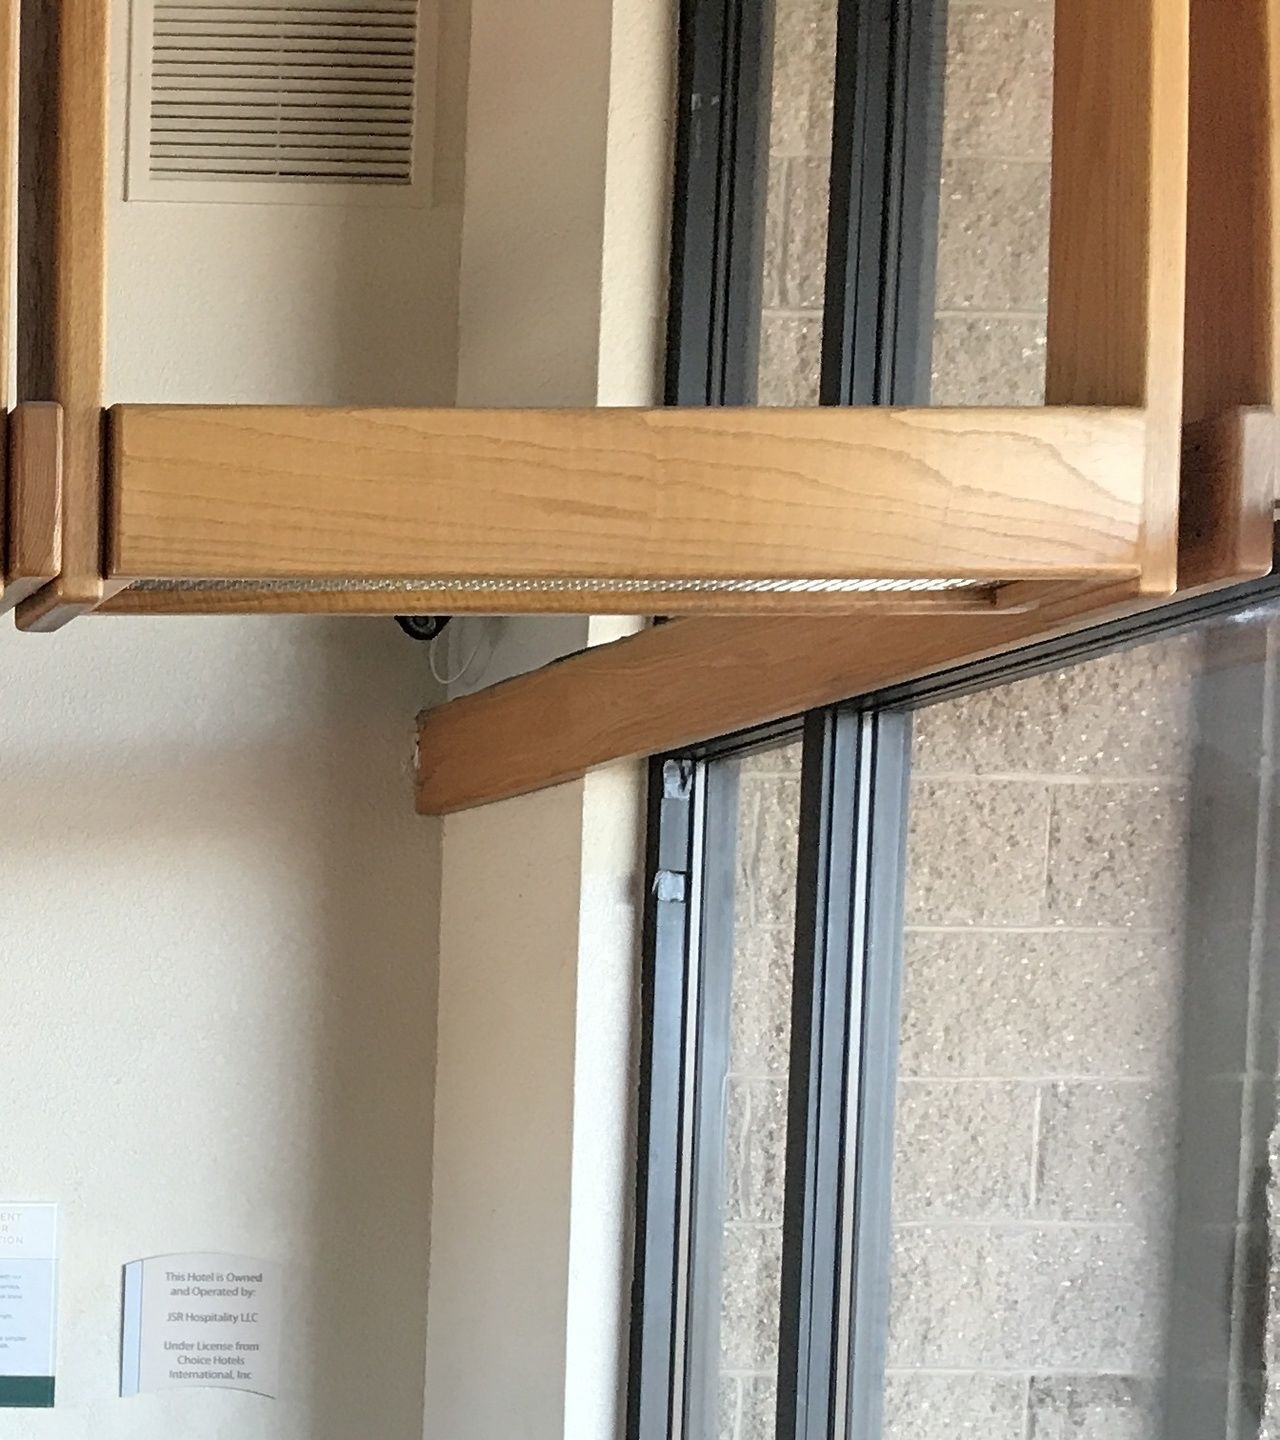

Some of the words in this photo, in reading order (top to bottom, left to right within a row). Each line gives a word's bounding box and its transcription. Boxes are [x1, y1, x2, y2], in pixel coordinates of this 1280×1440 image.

[165, 1271, 185, 1282] This
[187, 1272, 214, 1282] Hotel
[216, 1272, 224, 1282] is
[226, 1272, 263, 1282] Owned
[170, 1287, 190, 1296] and
[192, 1287, 238, 1298] Operated
[185, 1312, 238, 1324] Hospitality
[240, 1312, 259, 1322] LLC
[164, 1341, 194, 1351] Under
[197, 1341, 234, 1351] License
[235, 1341, 259, 1351] from
[177, 1355, 212, 1365] Choice
[213, 1355, 245, 1365] Hotels
